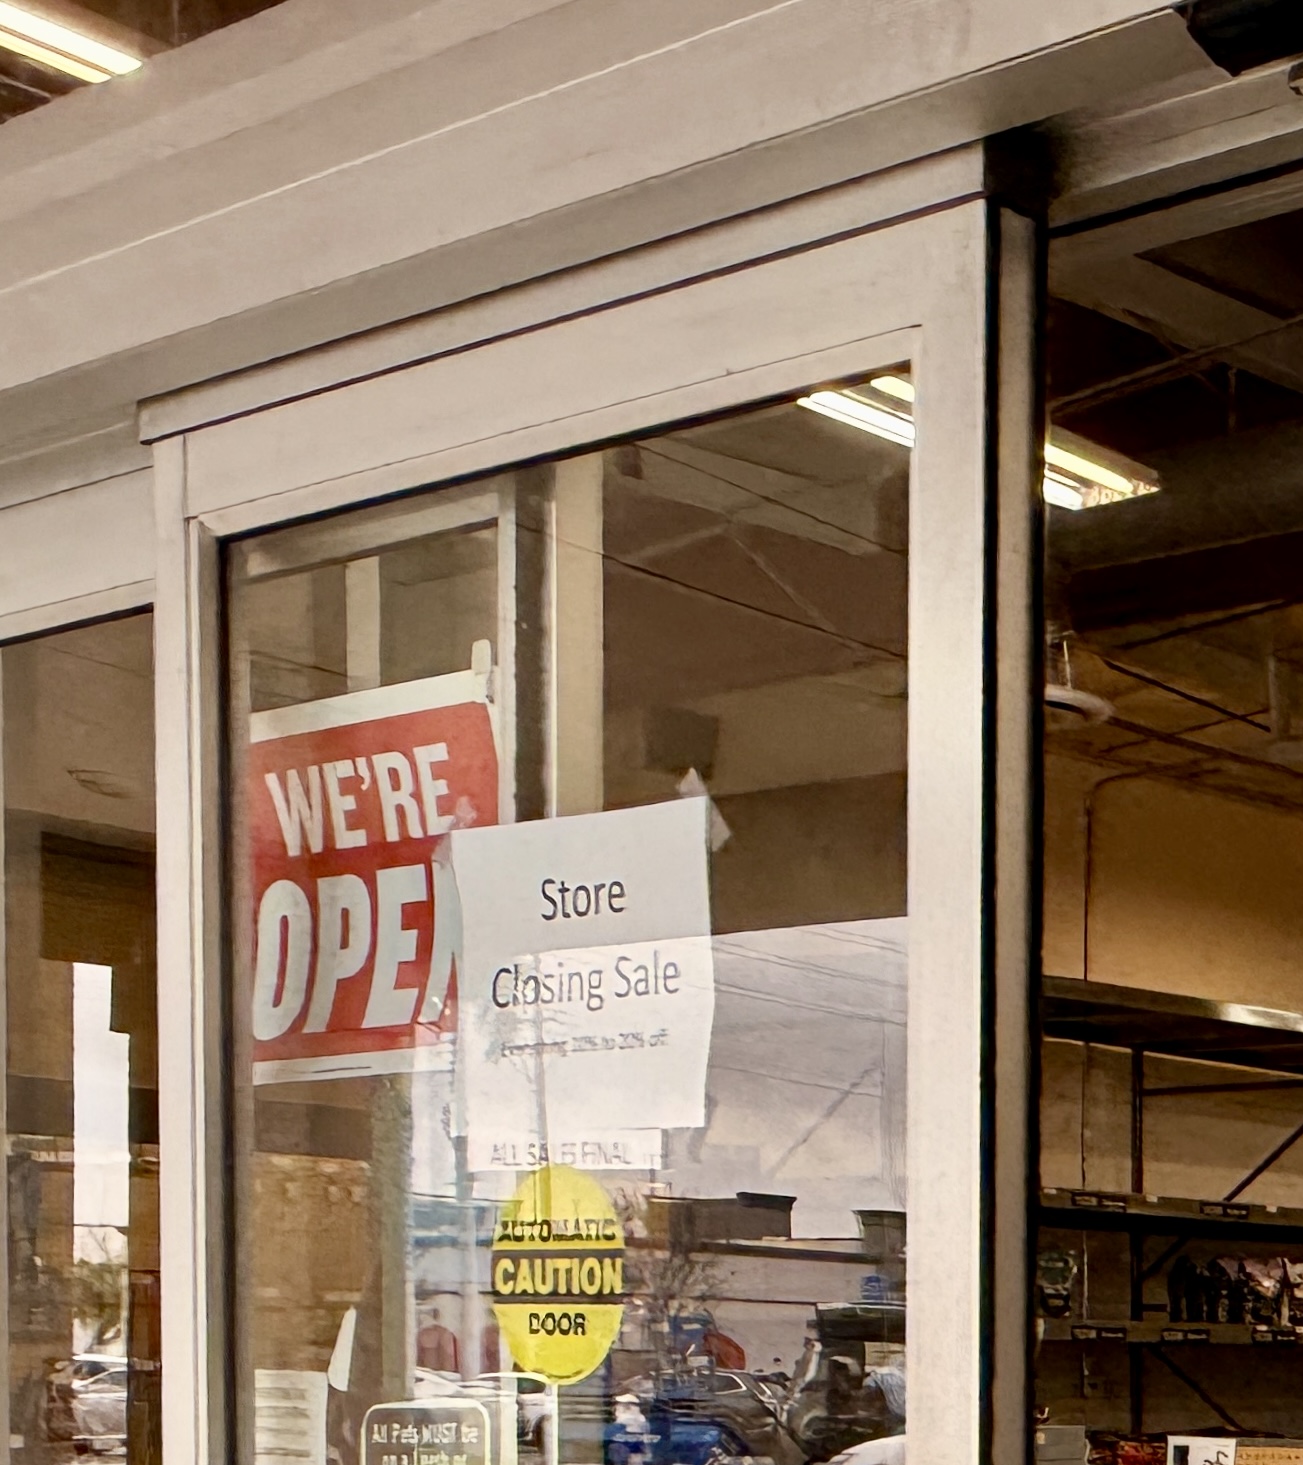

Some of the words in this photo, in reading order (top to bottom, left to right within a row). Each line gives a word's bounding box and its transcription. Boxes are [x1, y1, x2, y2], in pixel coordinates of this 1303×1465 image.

[265, 742, 456, 857] WE'RE
[541, 878, 626, 921] Store
[492, 960, 605, 1012] Closing
[613, 949, 681, 998] Sale
[497, 1219, 616, 1242] AUTOMATIC
[494, 1258, 623, 1295] CAUTION
[528, 1312, 586, 1336] DOOR
